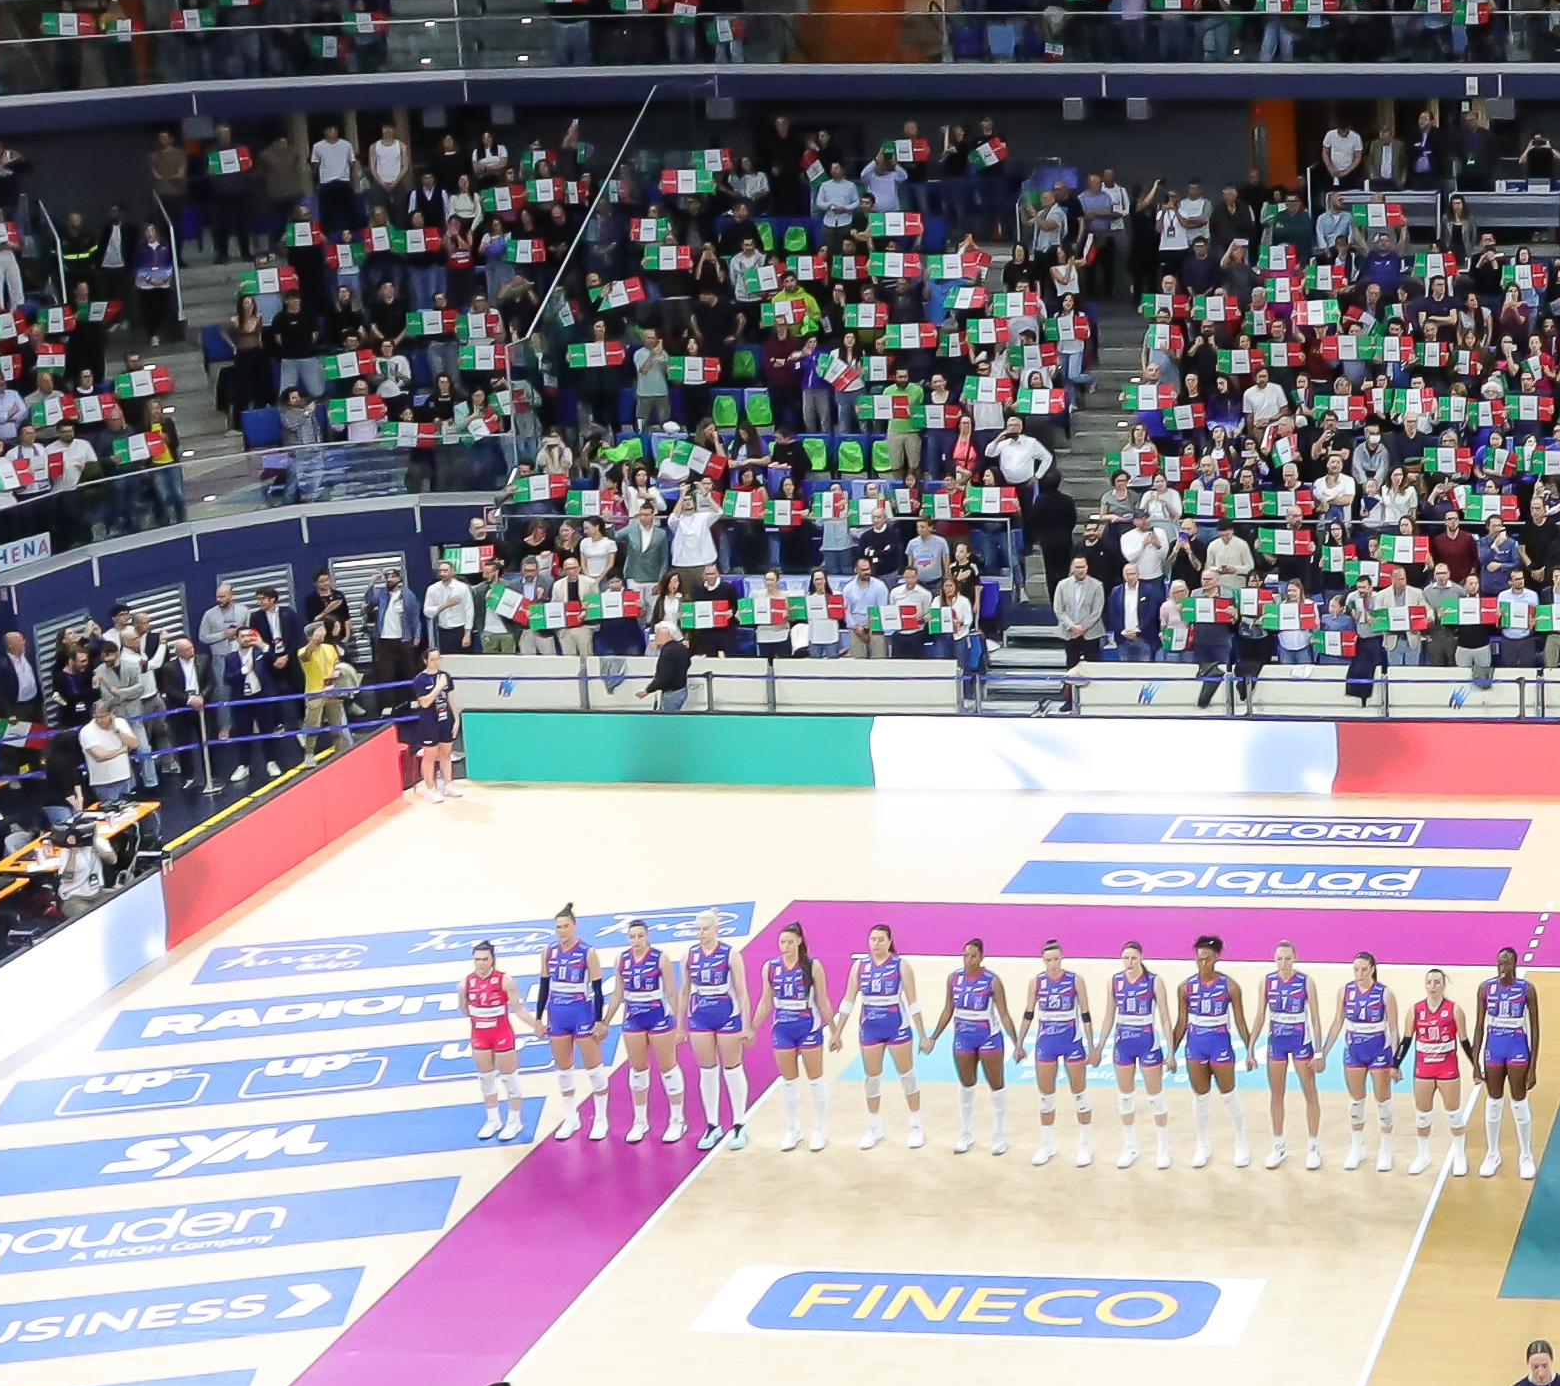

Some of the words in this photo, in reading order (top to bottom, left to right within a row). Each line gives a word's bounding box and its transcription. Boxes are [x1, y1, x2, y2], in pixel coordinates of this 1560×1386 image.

[1190, 821, 1403, 841] TRIFORM
[1101, 865, 1423, 895] opiquad
[100, 1123, 329, 1178] SYM
[69, 1250, 88, 1263] A
[94, 1244, 165, 1261] RICOH
[171, 1232, 274, 1255] Company
[788, 1282, 1181, 1328] FINECO
